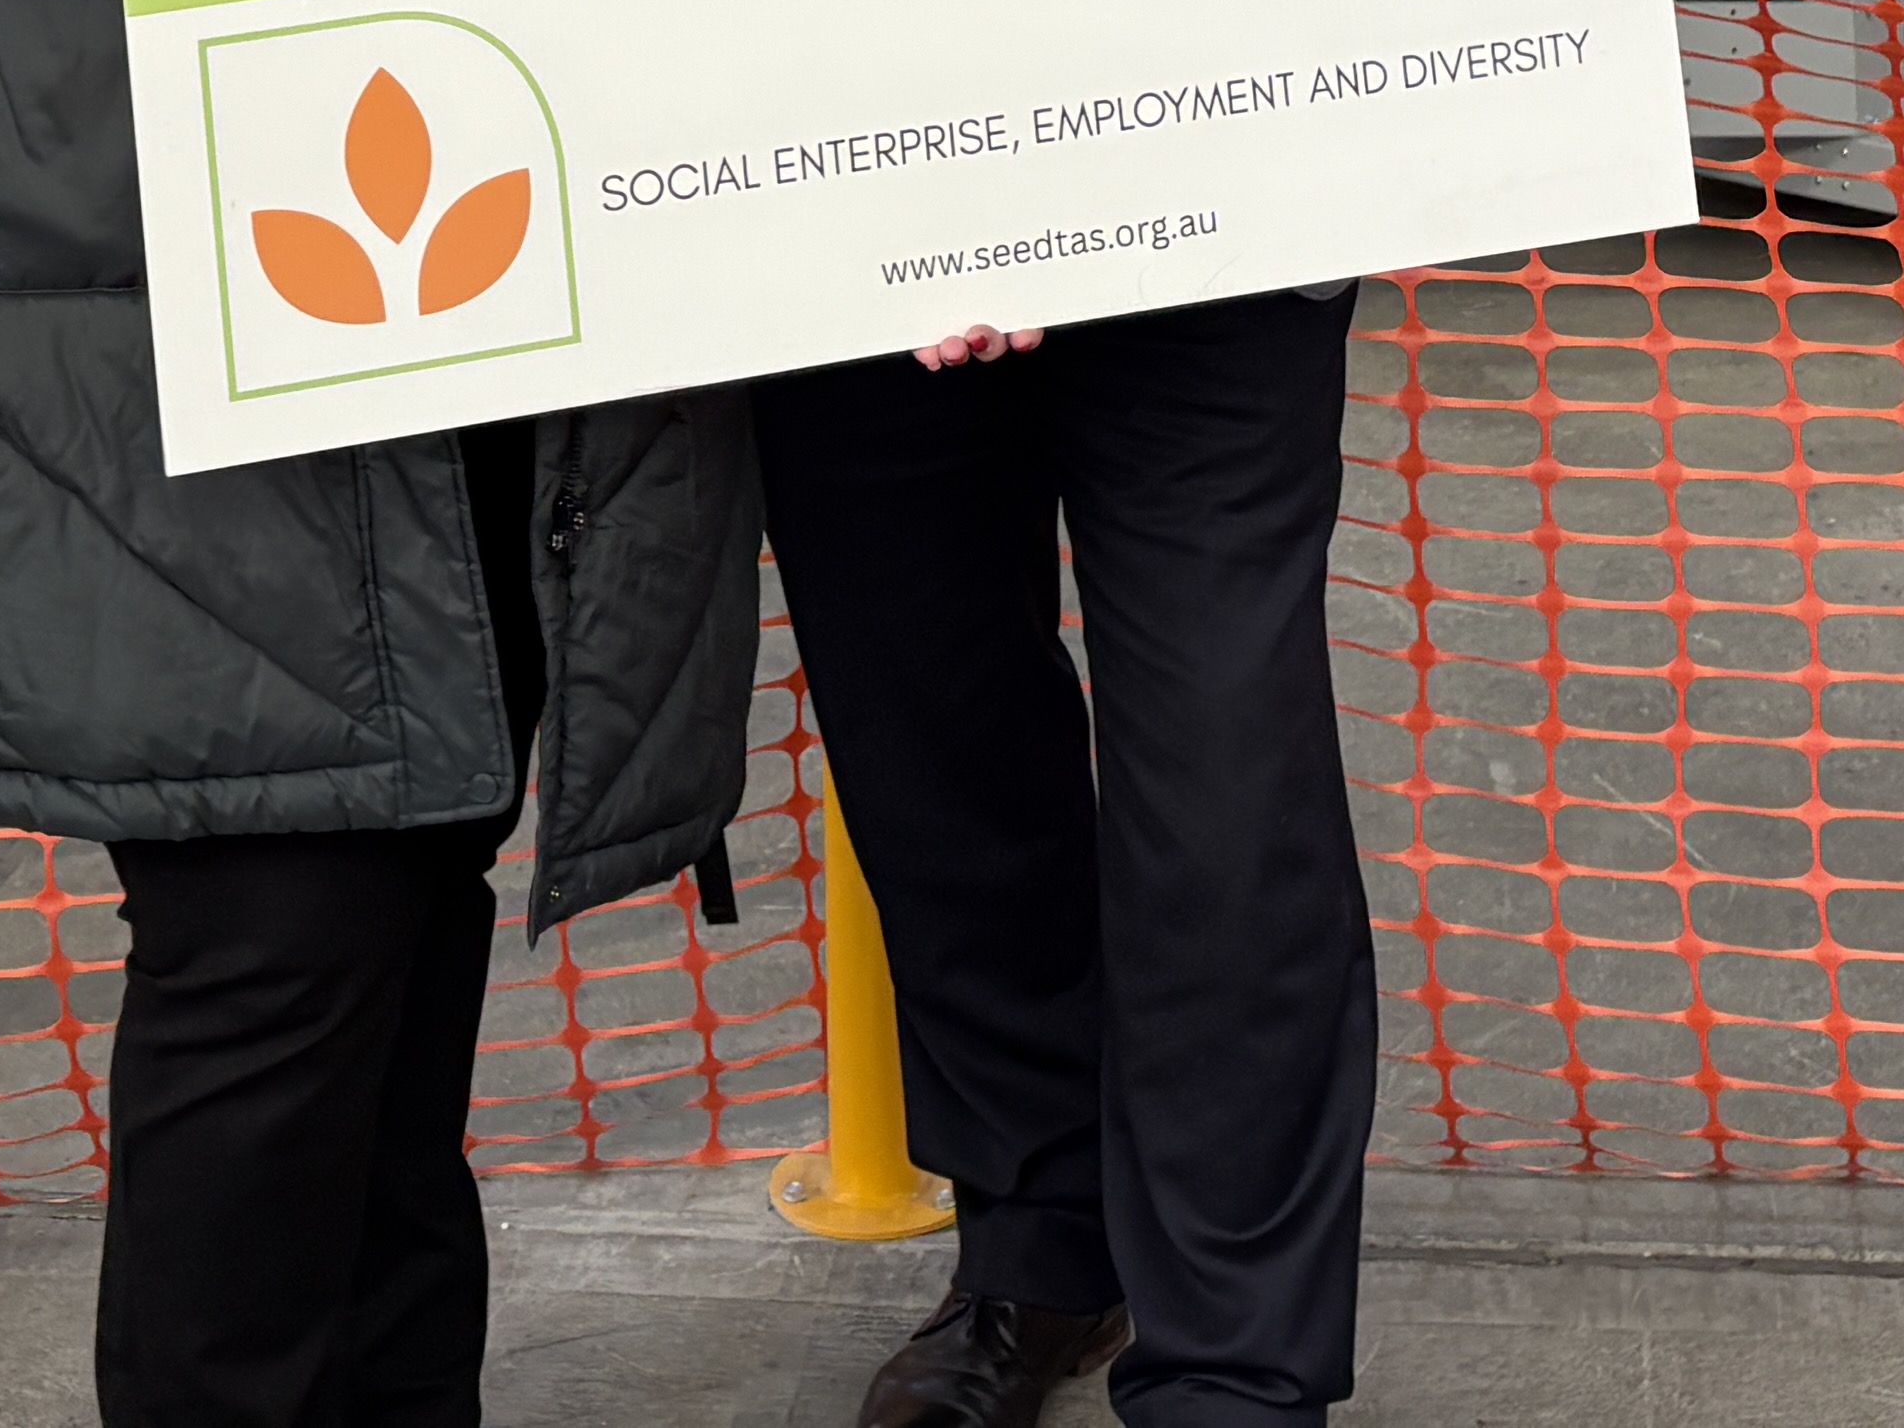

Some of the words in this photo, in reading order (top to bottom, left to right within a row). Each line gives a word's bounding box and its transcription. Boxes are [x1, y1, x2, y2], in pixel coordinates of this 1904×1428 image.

[601, 153, 761, 211] SOCIAL
[774, 114, 1020, 185] ENTERPRISE,
[1033, 71, 1295, 145] EMPLOYMENT
[1309, 59, 1389, 104] AND
[1401, 28, 1590, 89] DIVERSITY
[881, 210, 1218, 286] www.seedtas.org.au
